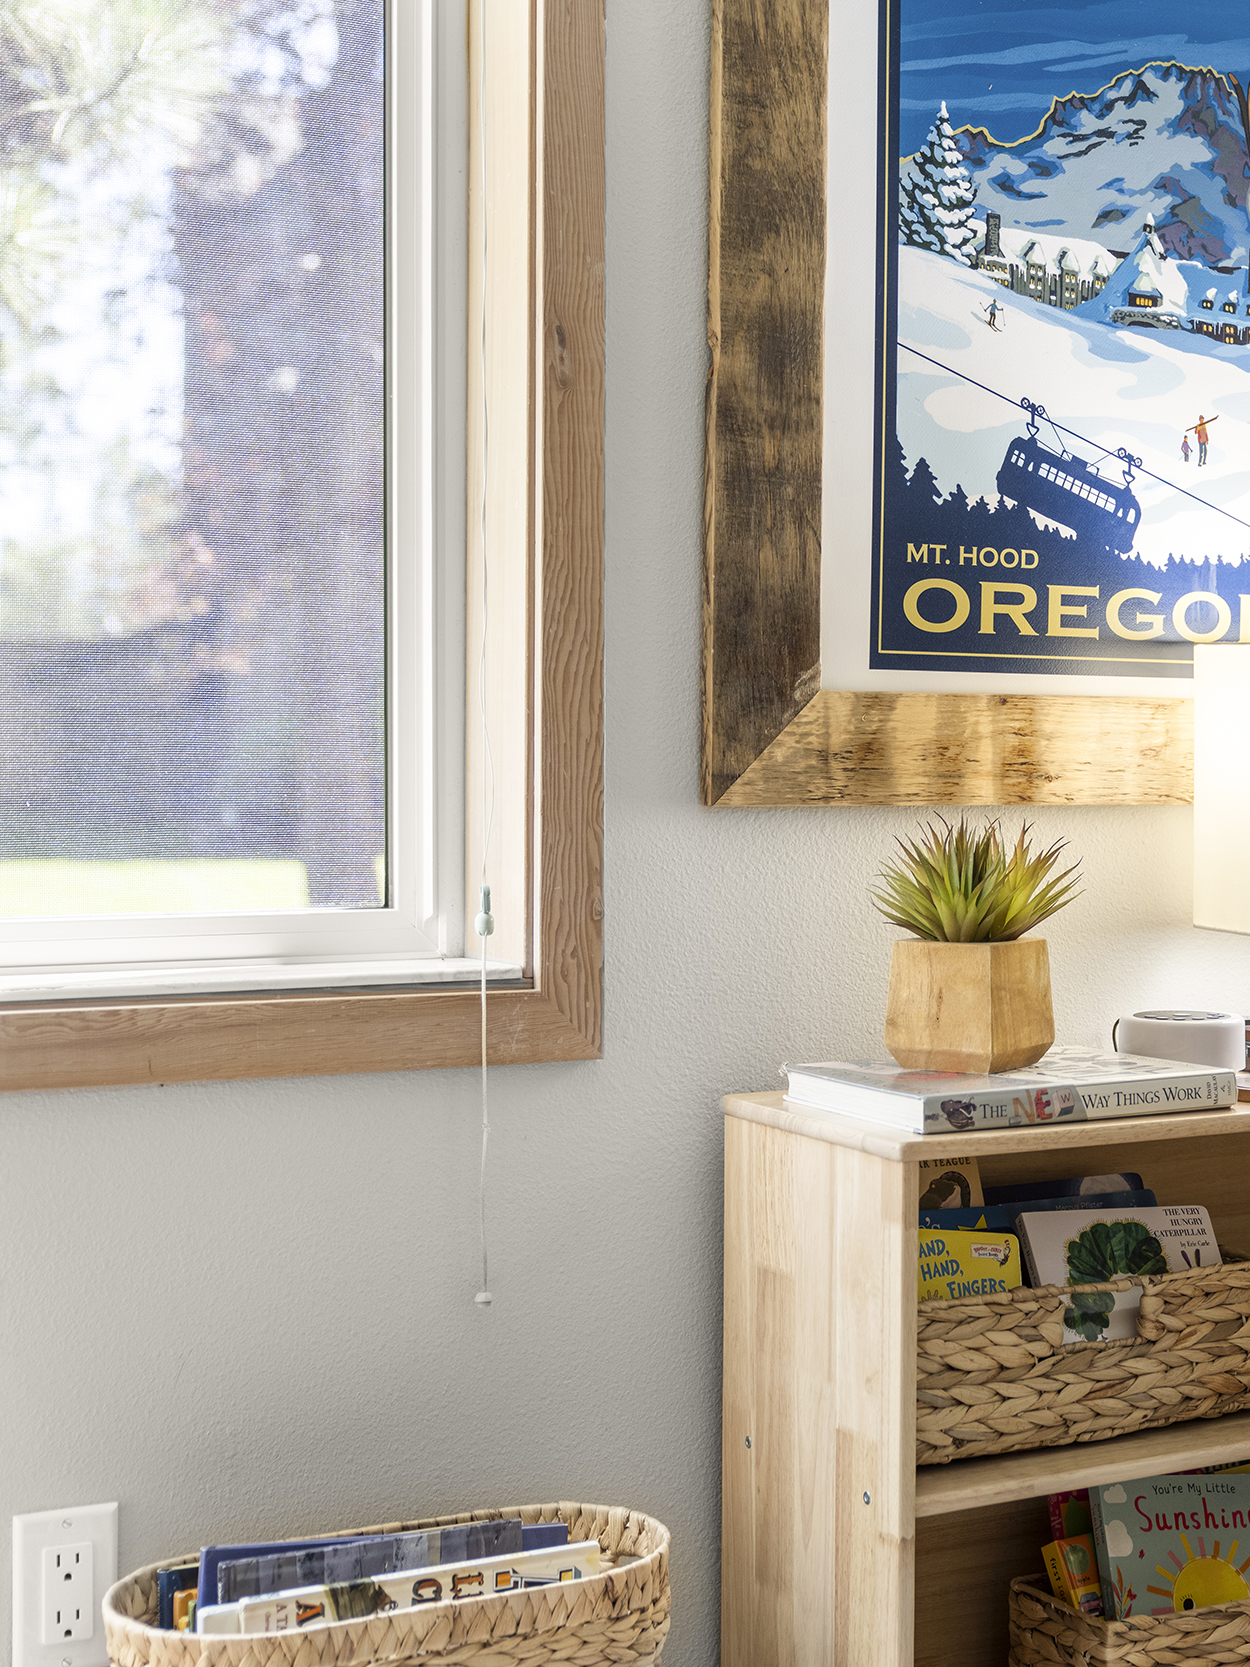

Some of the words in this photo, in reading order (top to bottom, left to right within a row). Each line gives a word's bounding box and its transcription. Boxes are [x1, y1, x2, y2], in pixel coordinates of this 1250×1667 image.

[907, 543, 951, 565] MT.
[959, 546, 1039, 569] HOOD
[979, 1103, 1008, 1119] THE
[1012, 1088, 1074, 1123] NEW
[1081, 1093, 1111, 1109] WAY
[1113, 1090, 1161, 1107] THINGS
[1162, 1086, 1202, 1102] WORK
[932, 1156, 971, 1168] TEAGUE
[1163, 1208, 1180, 1216] THE
[1180, 1207, 1200, 1215] VERY
[1170, 1217, 1203, 1226] HUNGRY
[1153, 1228, 1207, 1237] CATERPILLAR
[918, 1239, 950, 1260] AND,
[920, 1259, 964, 1282] HAND,
[1152, 1483, 1183, 1495] You're
[1187, 1483, 1201, 1495] My
[1205, 1483, 1236, 1494] Little
[1050, 1557, 1061, 1581] first
[1077, 1576, 1090, 1585] apple
